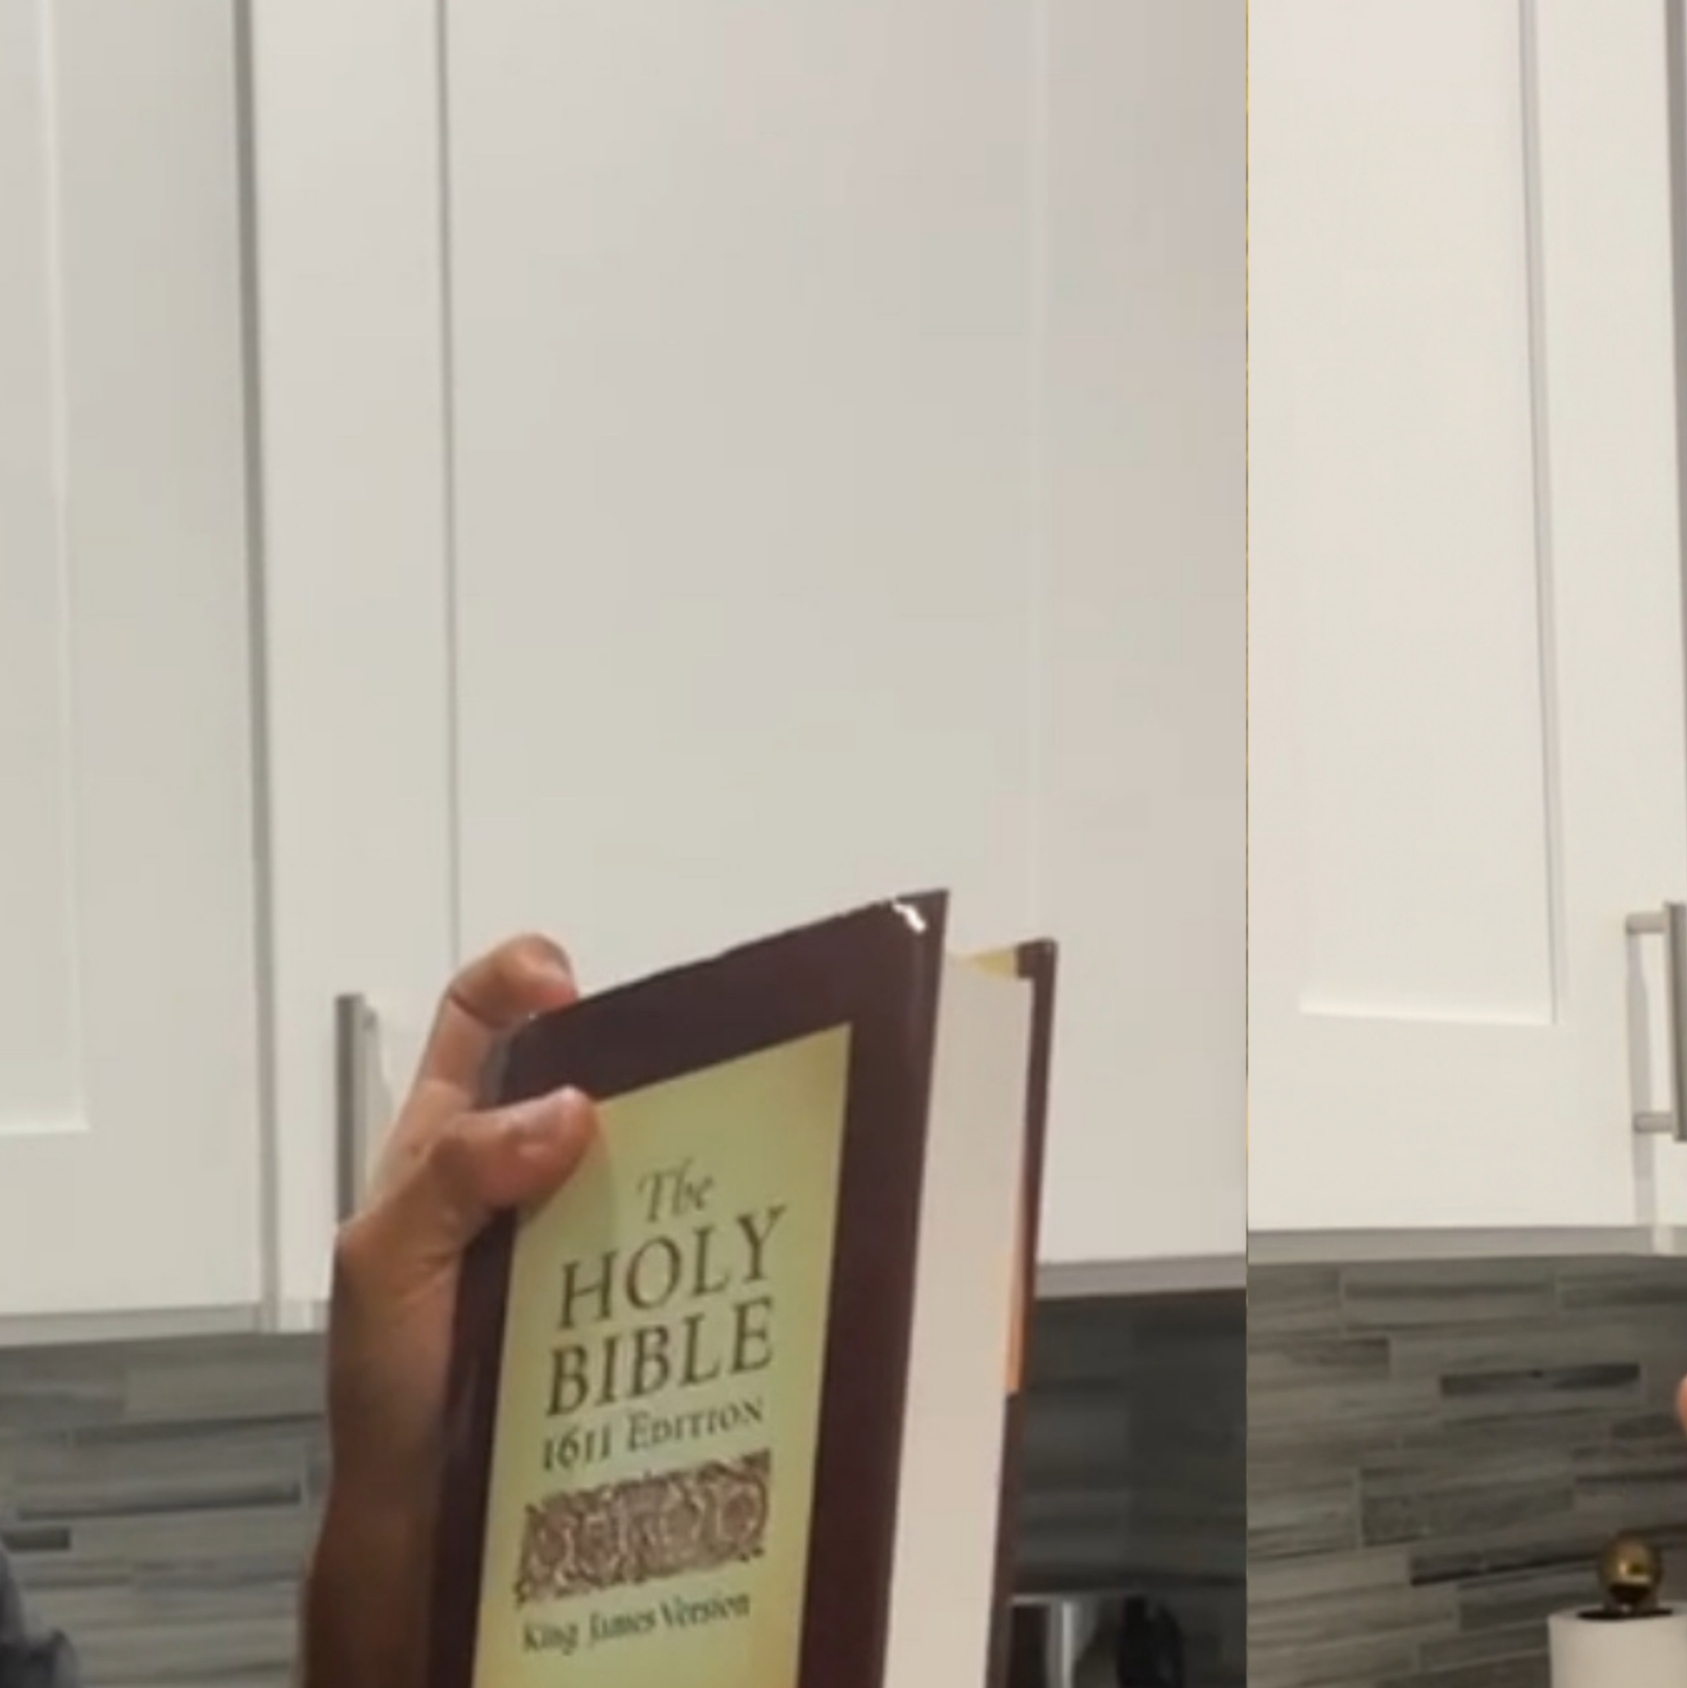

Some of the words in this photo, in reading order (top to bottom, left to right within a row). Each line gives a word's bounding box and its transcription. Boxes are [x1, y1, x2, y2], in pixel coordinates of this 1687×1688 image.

[637, 1156, 714, 1223] The
[557, 1203, 788, 1331] HOLY
[545, 1296, 775, 1418] BIBLE
[542, 1425, 612, 1471] 1611
[523, 1618, 579, 1657] King
[587, 1610, 657, 1650] James
[659, 1592, 752, 1629] Version
